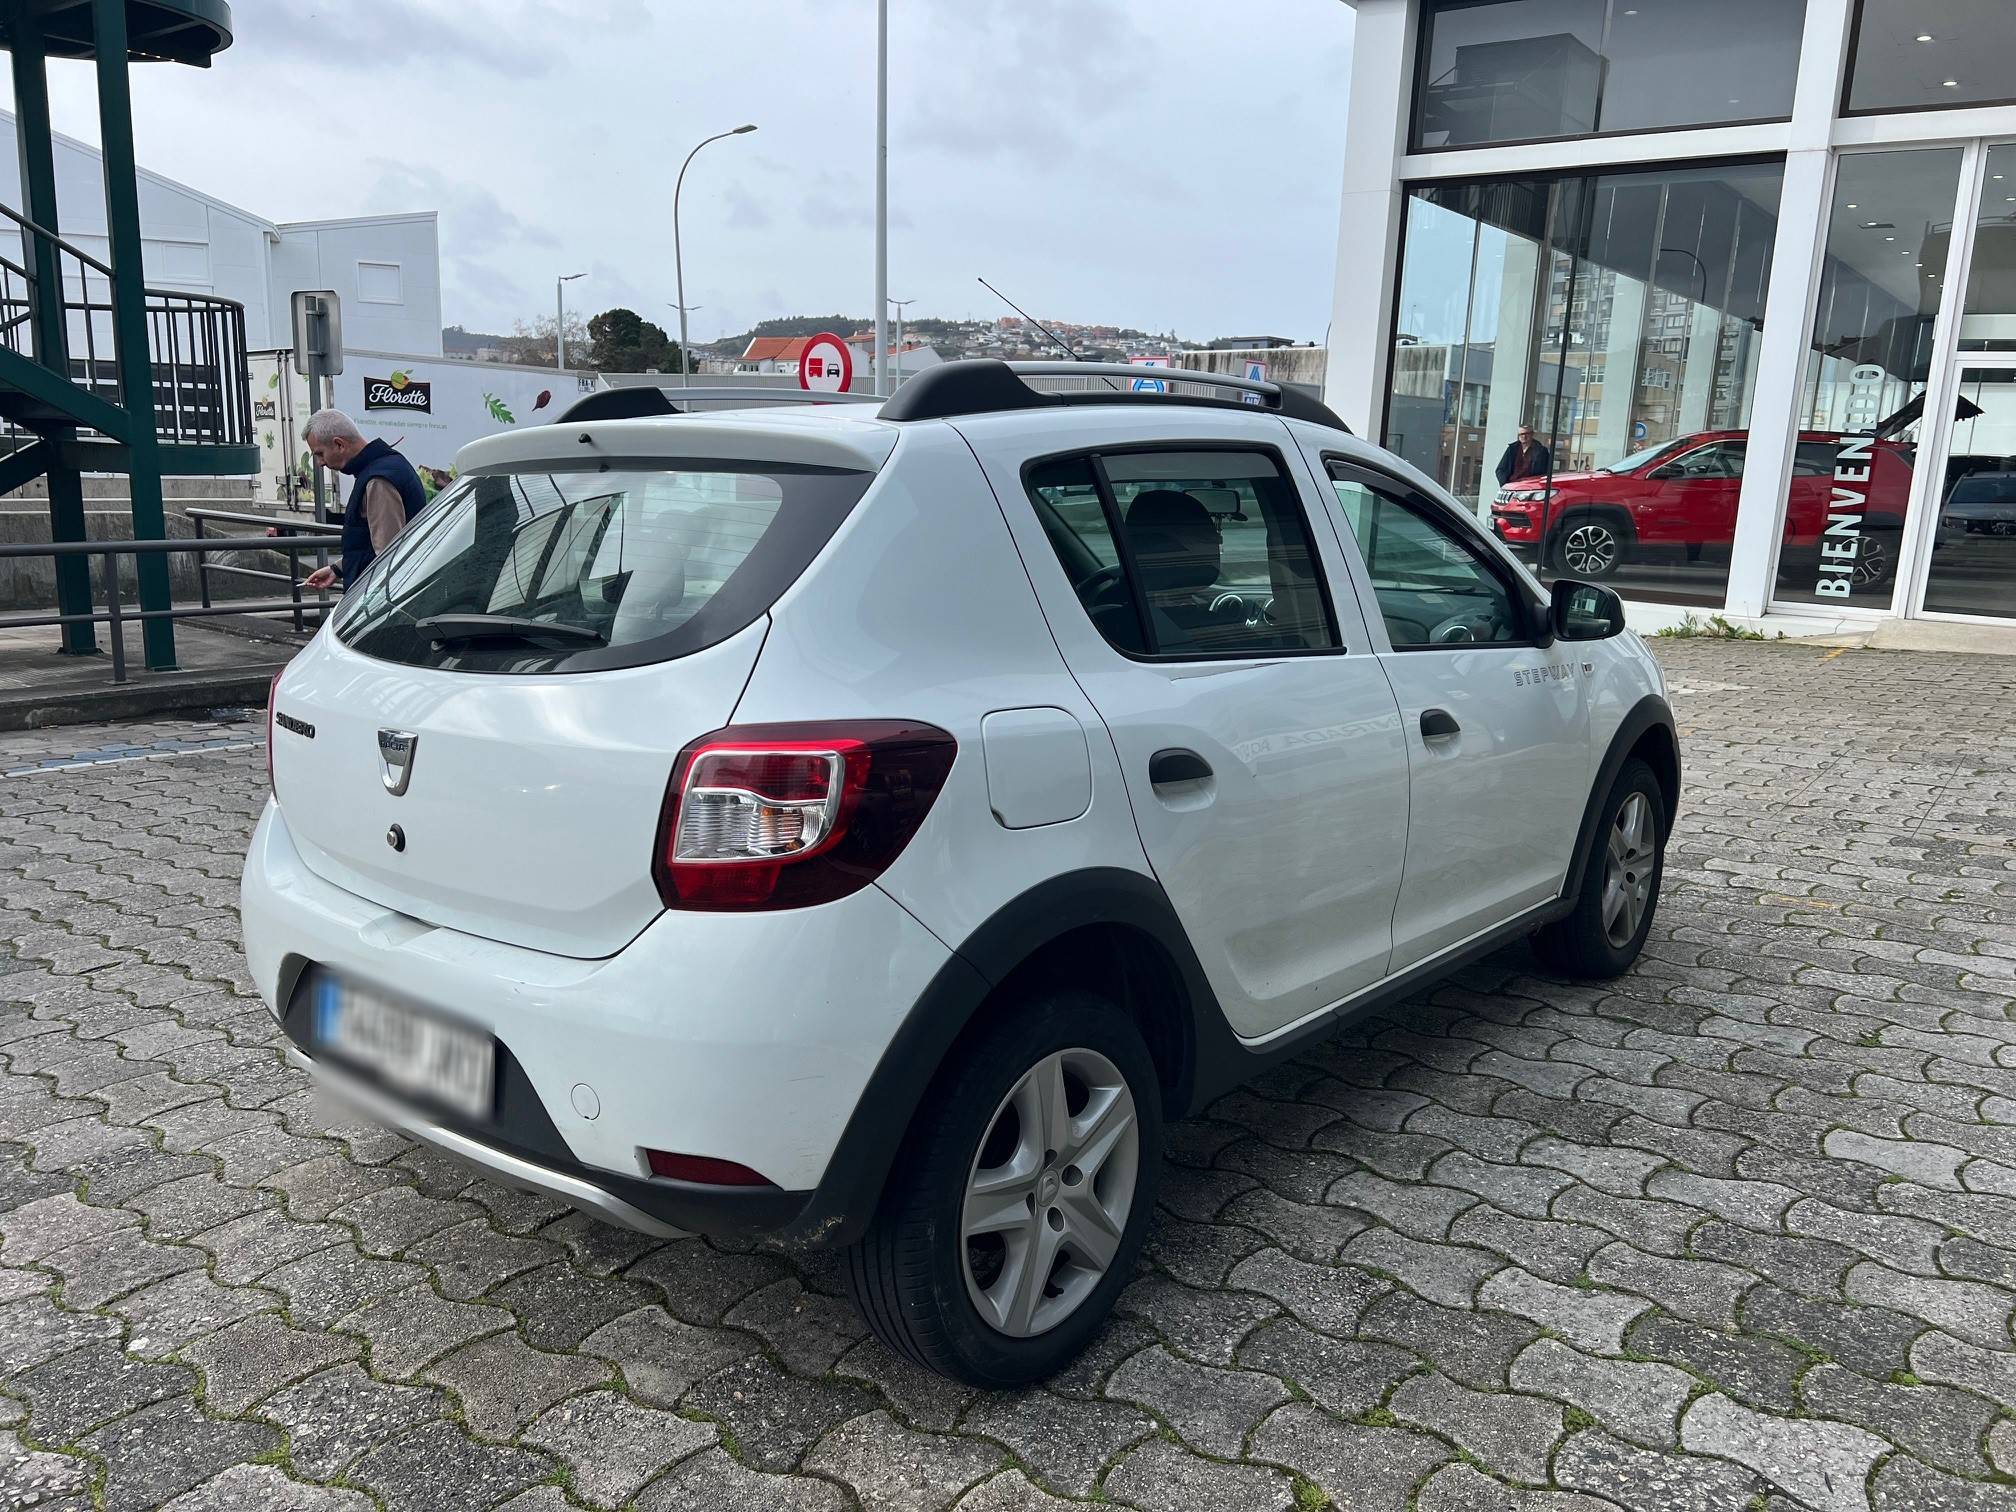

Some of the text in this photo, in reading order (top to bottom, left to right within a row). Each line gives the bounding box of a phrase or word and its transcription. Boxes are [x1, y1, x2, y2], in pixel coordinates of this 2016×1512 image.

[369, 383, 428, 406] Florette
[1815, 363, 1886, 598] BIENVENIDO
[1513, 662, 1574, 687] STEPWAY
[276, 711, 316, 739] SANDERO
